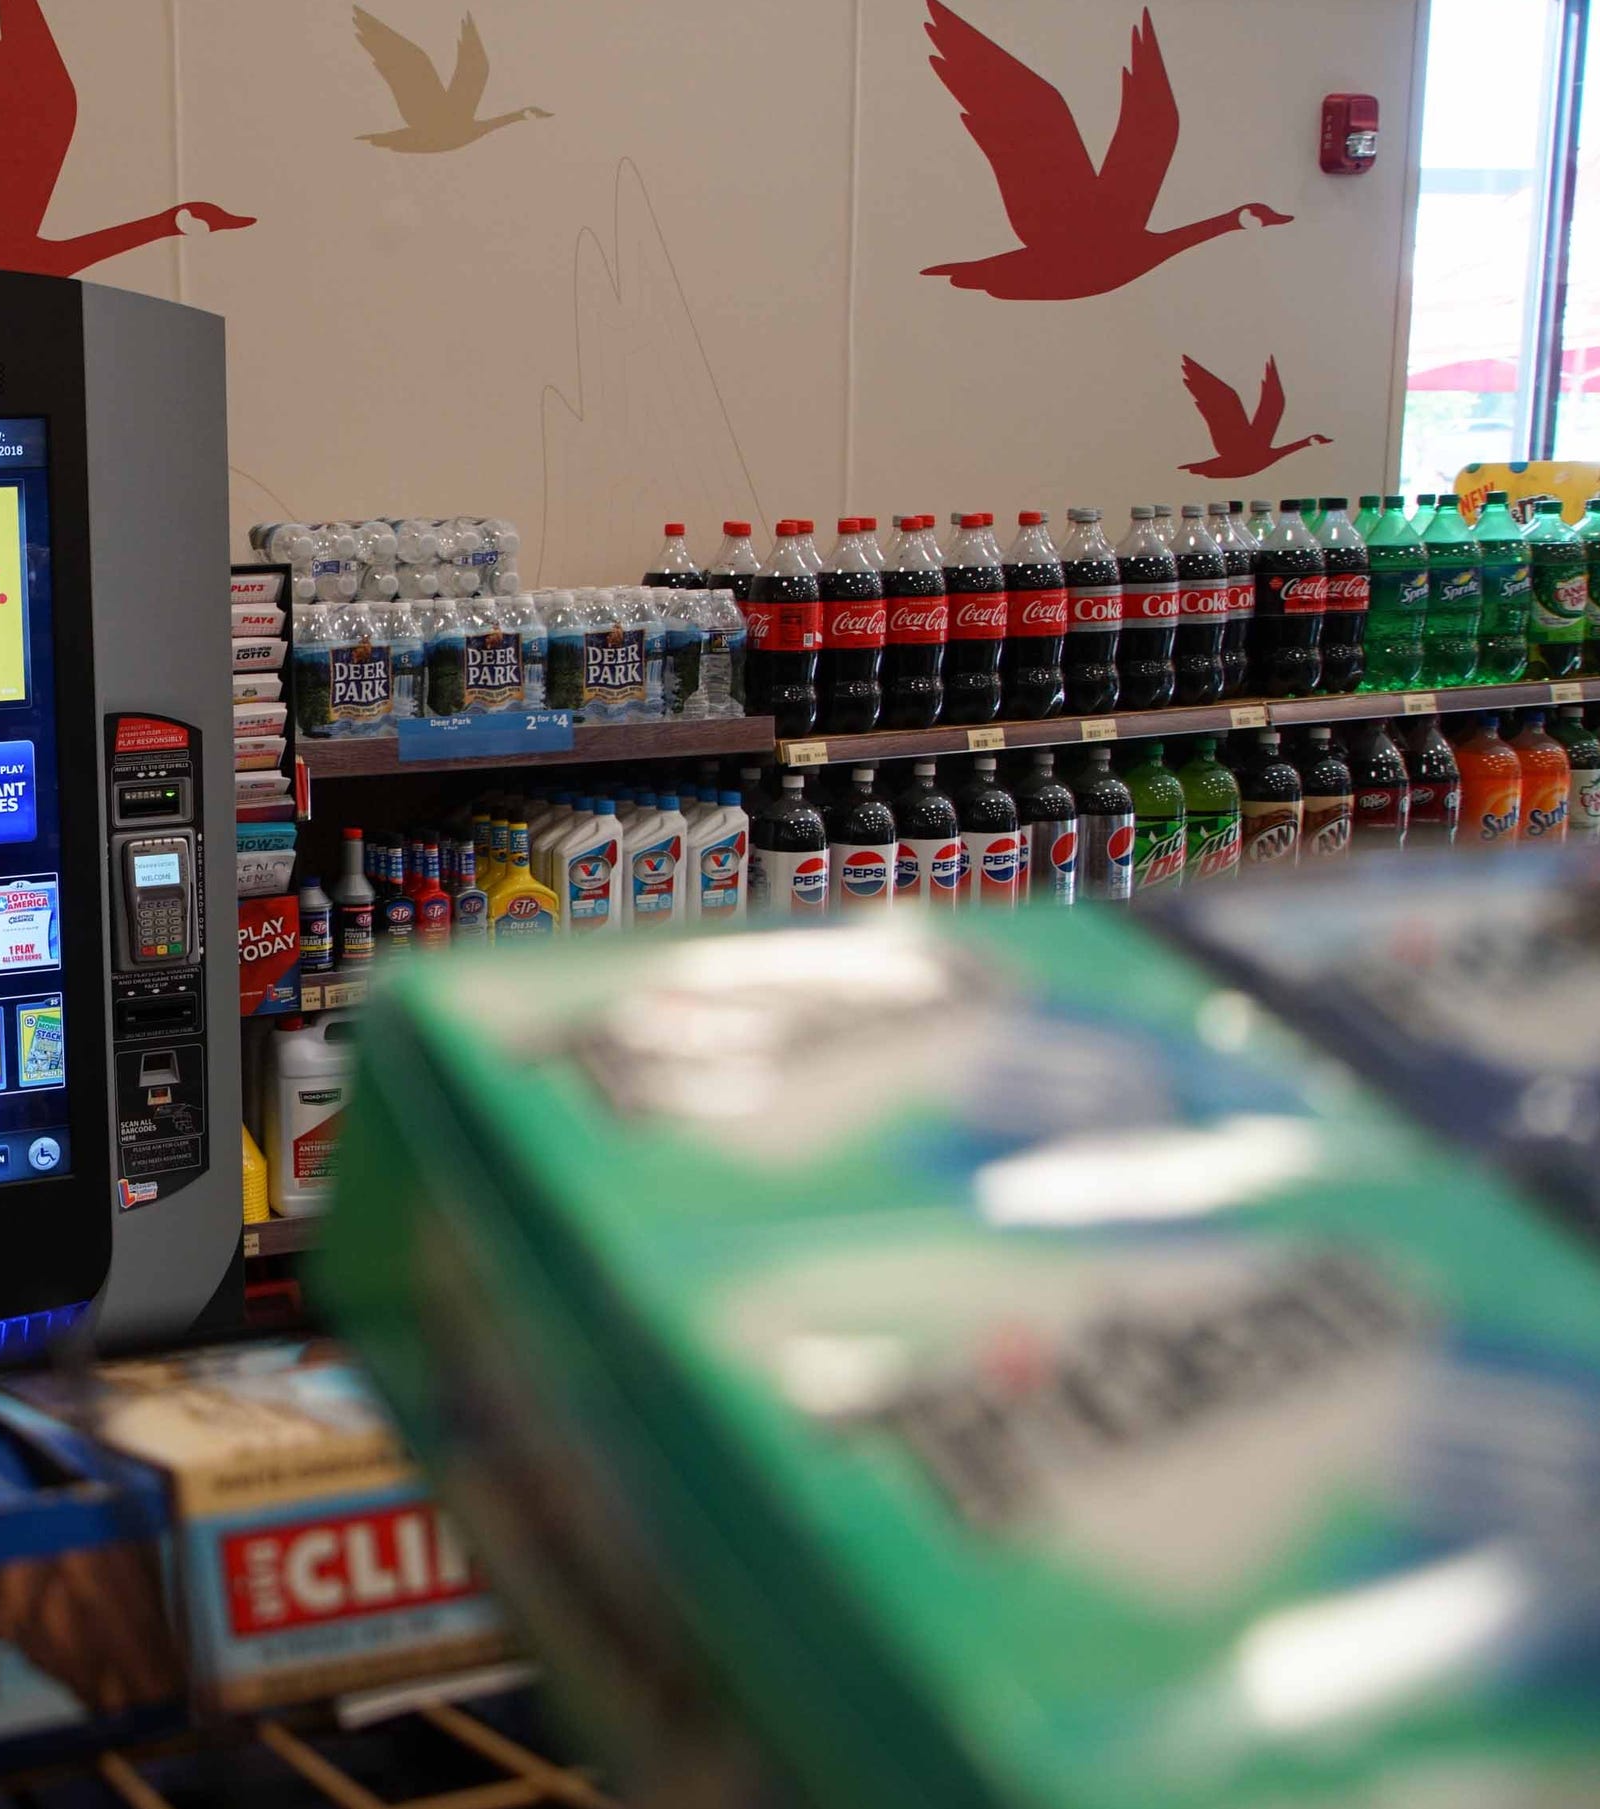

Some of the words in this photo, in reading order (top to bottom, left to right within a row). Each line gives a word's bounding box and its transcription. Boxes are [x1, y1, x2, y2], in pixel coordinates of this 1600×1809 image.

[1181, 590, 1228, 613] Coke
[1228, 586, 1256, 609] Cok
[1074, 597, 1122, 621] Coke
[1142, 594, 1179, 617] Cok
[241, 616, 274, 625] PLAY4
[236, 651, 270, 661] LOTTO
[467, 646, 518, 666] DEER
[587, 643, 641, 665] DEER
[334, 660, 388, 682] DEER
[467, 665, 520, 686] PARK
[587, 663, 642, 686] PARK
[333, 679, 388, 704] PARK
[429, 718, 450, 728] Deer
[452, 716, 472, 726] Park
[525, 715, 538, 730] 2
[537, 714, 550, 723] for
[552, 713, 569, 728] $4
[118, 739, 136, 747] PLAY
[136, 735, 184, 745] RESPONSIBLY
[0, 764, 25, 776] PLAY
[983, 855, 1018, 865] PEPS
[141, 872, 172, 882] WELCOME
[842, 866, 887, 878] PEPSI
[793, 873, 828, 887] PEPS
[7, 893, 36, 903] LOTTO
[7, 898, 48, 910] AMERICA
[428, 905, 444, 917] STP
[465, 900, 481, 912] STP
[513, 899, 536, 915] STP
[391, 908, 409, 922] STP
[238, 916, 284, 945] PLAY
[312, 921, 327, 934] STP
[14, 943, 35, 954] PLAY
[120, 1120, 139, 1128] SCAN
[140, 1118, 153, 1126] ALL
[121, 1124, 157, 1135] BARCODES
